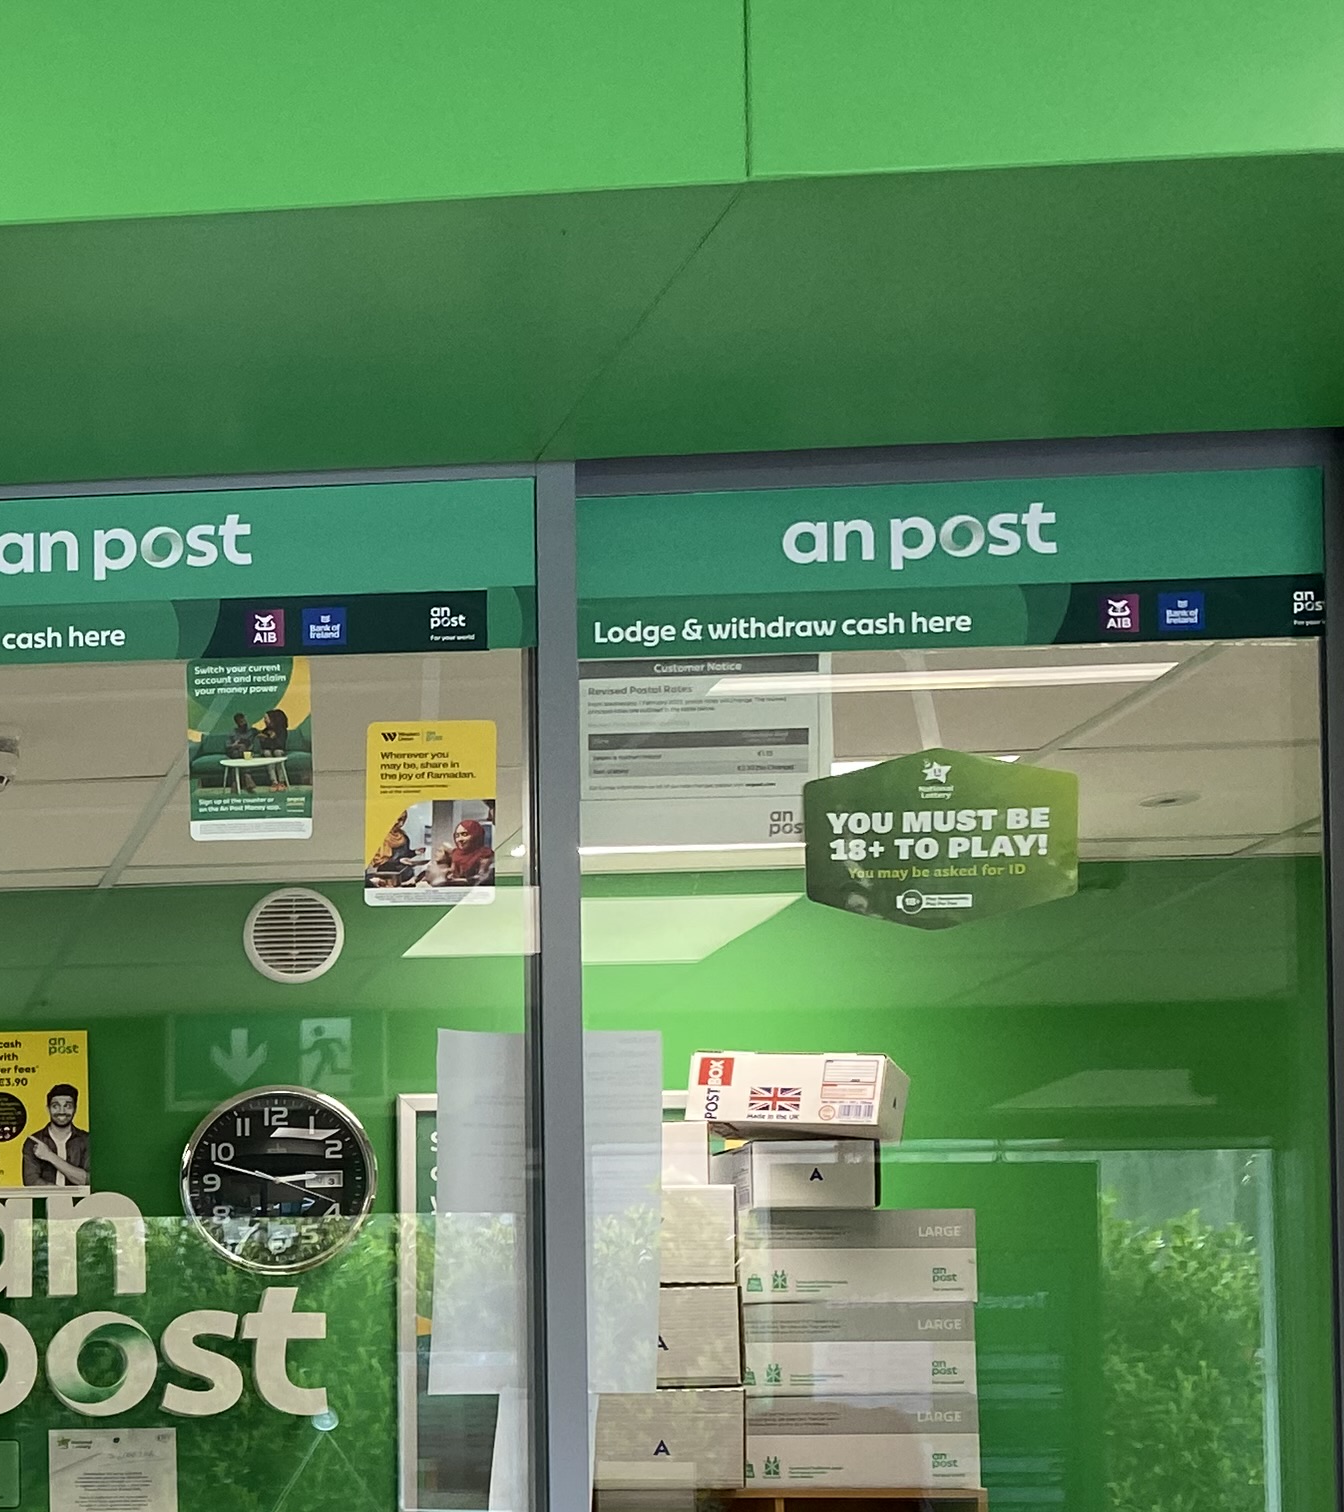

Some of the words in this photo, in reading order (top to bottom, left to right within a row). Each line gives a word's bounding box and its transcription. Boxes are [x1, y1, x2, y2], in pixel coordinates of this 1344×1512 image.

[782, 519, 876, 564] an
[889, 501, 1058, 570] post
[93, 514, 252, 581] post
[1293, 591, 1314, 601] an
[430, 606, 450, 617] an
[309, 624, 330, 633] Bank
[430, 613, 467, 630] post
[1106, 618, 1132, 629] AIB
[309, 630, 340, 640] Ireland
[594, 621, 677, 647] Lodge
[681, 618, 702, 640] &
[708, 616, 836, 640] withdraw
[841, 613, 905, 636] cash
[911, 611, 972, 634] here
[2, 627, 62, 650] cash
[68, 626, 126, 648] here
[253, 632, 277, 644] AIB
[195, 665, 224, 674] Switch
[248, 664, 280, 672] current
[654, 664, 705, 673] Customer
[707, 662, 742, 672] Notice
[770, 811, 793, 822] an
[827, 812, 893, 834] YOU
[902, 809, 998, 833] MUST
[1006, 807, 1050, 829] BE
[829, 839, 884, 861] 18+
[894, 838, 939, 860] TO
[948, 834, 1047, 858] PLAY!
[849, 868, 873, 879] You
[878, 868, 908, 881] may
[912, 866, 929, 878] be
[934, 865, 977, 877] asked
[981, 865, 1005, 876] for
[1009, 864, 1026, 875] ID
[49, 1038, 65, 1046] an
[49, 1045, 79, 1055] post
[707, 1060, 725, 1086] BOX
[704, 1088, 720, 1120] POST
[264, 1107, 288, 1126] 12
[211, 1143, 234, 1161] 10
[325, 1140, 343, 1158] 2
[810, 1168, 823, 1181] A
[203, 1173, 221, 1192] 9
[918, 1226, 962, 1237] LARGE
[918, 1319, 962, 1330] LARGE
[918, 1411, 962, 1422] LARGE
[653, 1440, 671, 1456] A
